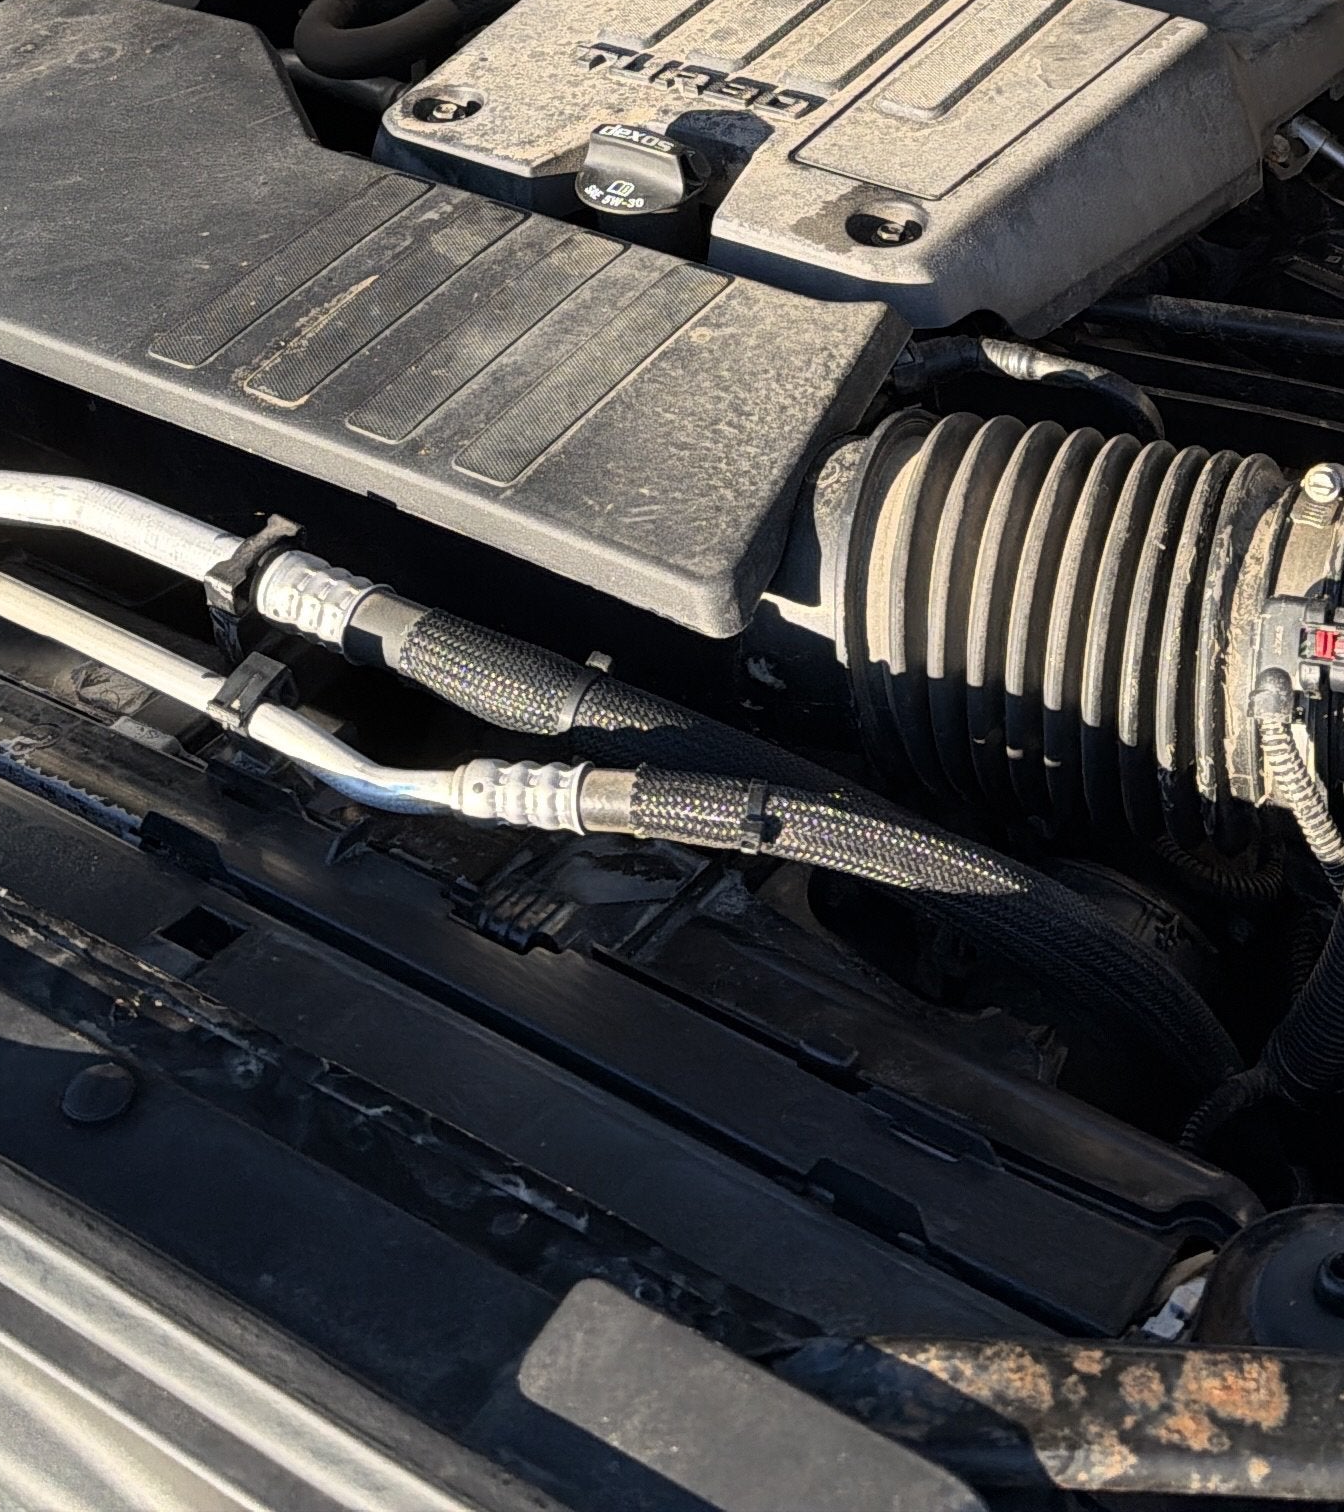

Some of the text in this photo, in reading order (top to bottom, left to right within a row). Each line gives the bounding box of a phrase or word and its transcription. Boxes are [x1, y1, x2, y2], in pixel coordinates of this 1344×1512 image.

[575, 43, 819, 120] TURBO
[598, 124, 675, 152] dexos
[584, 184, 645, 209] SAE 5W-30
